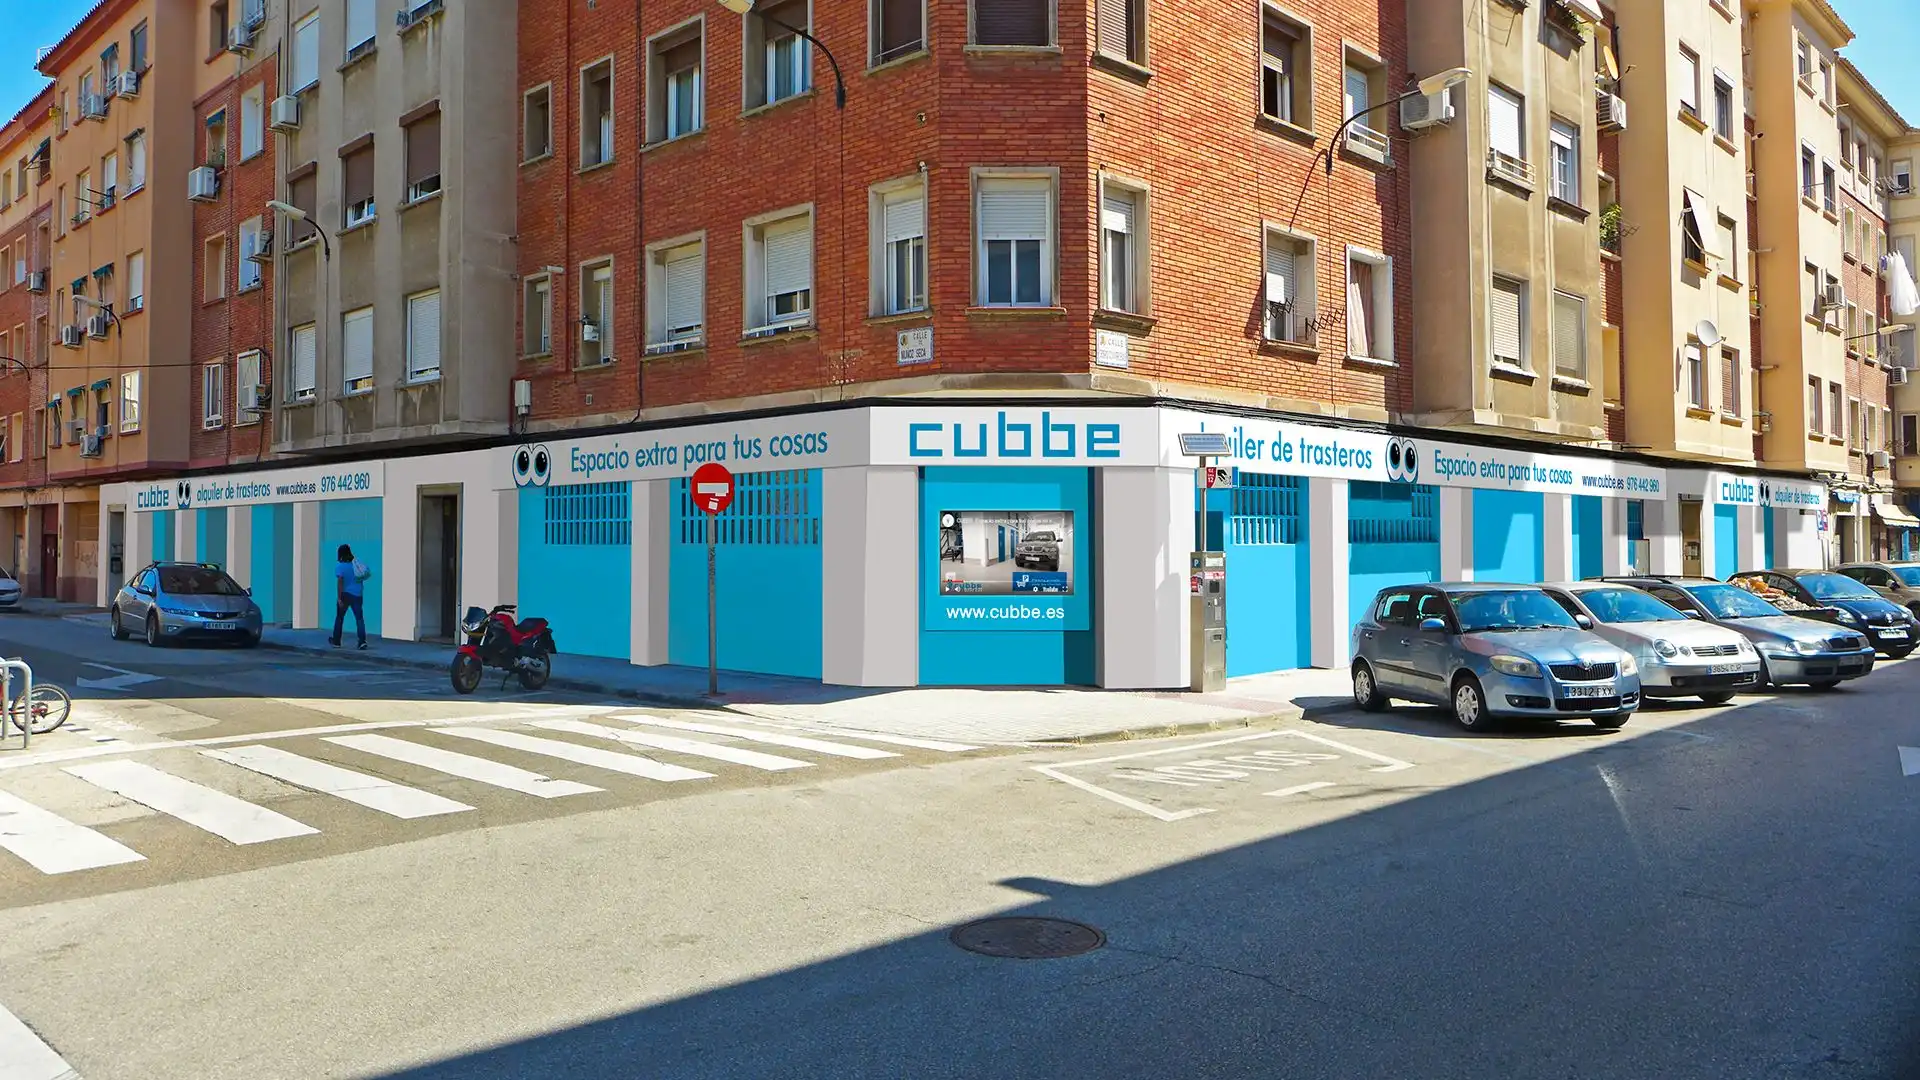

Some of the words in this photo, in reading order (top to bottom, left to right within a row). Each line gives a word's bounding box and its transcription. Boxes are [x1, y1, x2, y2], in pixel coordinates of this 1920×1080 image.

[908, 411, 1121, 458] cubbe
[570, 442, 629, 478] Espacio
[635, 443, 678, 469] extra
[683, 441, 727, 471] para
[733, 433, 763, 460] tus
[769, 430, 829, 458] cosas
[1271, 430, 1293, 462] de
[1299, 437, 1373, 470] trasteros
[1434, 449, 1477, 481] Espacio
[1480, 457, 1505, 480] extra
[1508, 463, 1531, 486] para
[1533, 462, 1547, 483] tus
[1549, 469, 1573, 485] cosas
[196, 482, 224, 505] alquiler
[225, 481, 235, 500] de
[236, 481, 271, 499] trasteros
[276, 481, 317, 495] www.cubbe.es
[321, 475, 336, 493] 976
[337, 473, 353, 491] 442
[354, 472, 370, 490] 960
[1581, 474, 1625, 490] www.cubbe.es
[1626, 476, 1638, 492] 976
[1722, 477, 1754, 503] cubbe
[137, 485, 169, 509] cubbe
[946, 604, 1065, 619] www.cubbe.es
[1571, 687, 1594, 697] 3312
